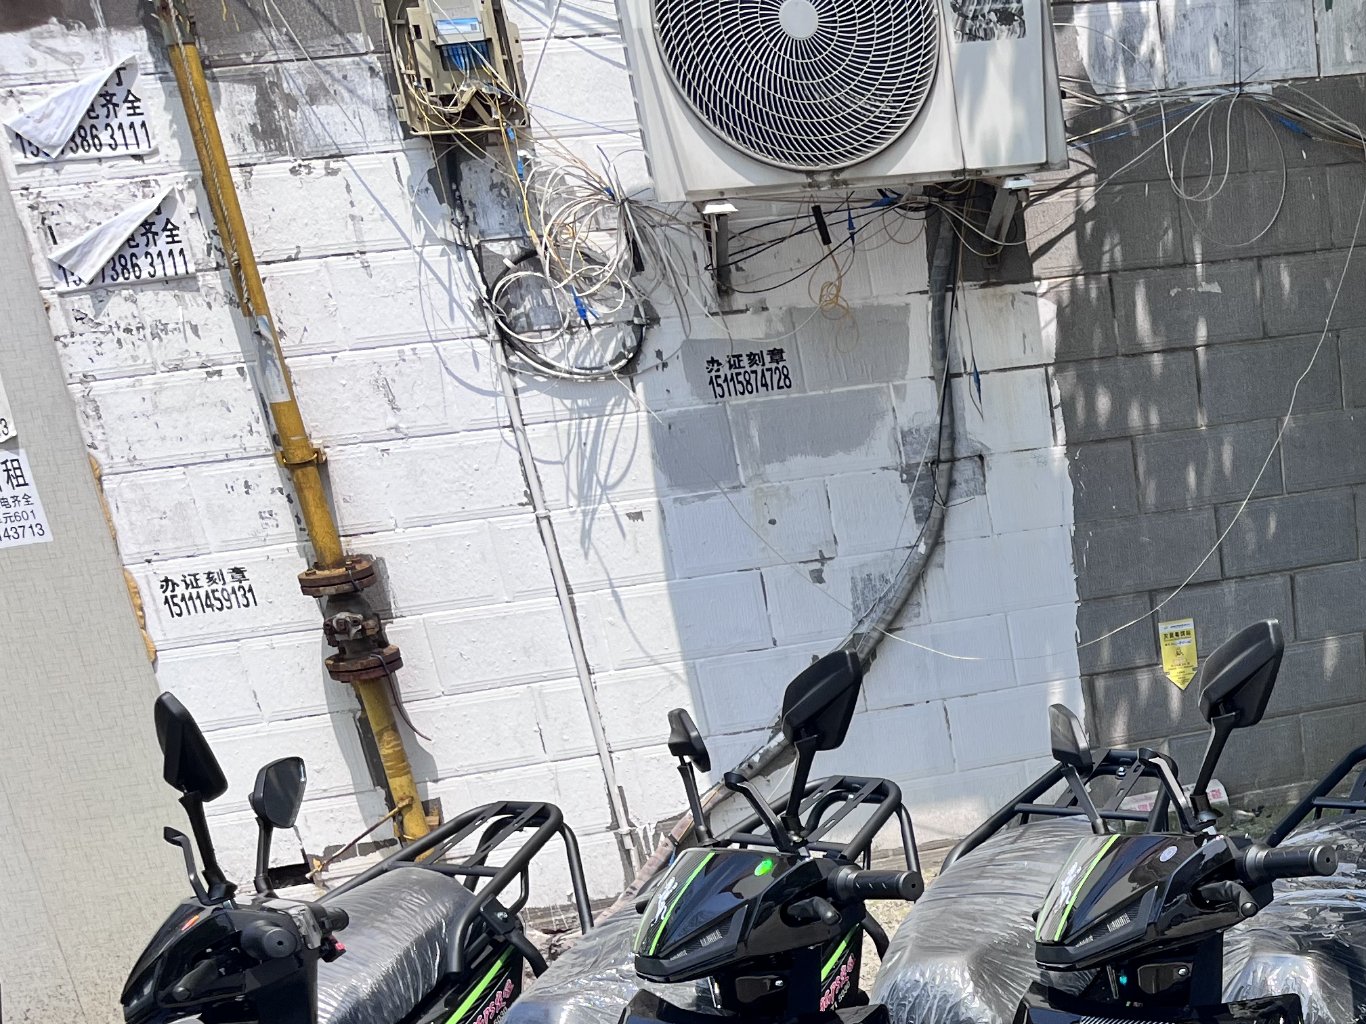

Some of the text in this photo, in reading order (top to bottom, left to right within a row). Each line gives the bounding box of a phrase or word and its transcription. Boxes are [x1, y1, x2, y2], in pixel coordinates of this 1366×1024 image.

[705, 348, 787, 373] 办证刻章
[708, 365, 792, 399] 15115874728
[0, 509, 36, 524] 元601
[0, 523, 45, 542] 43713
[160, 566, 250, 593] 办证刻章
[164, 584, 258, 618] 15111459131
